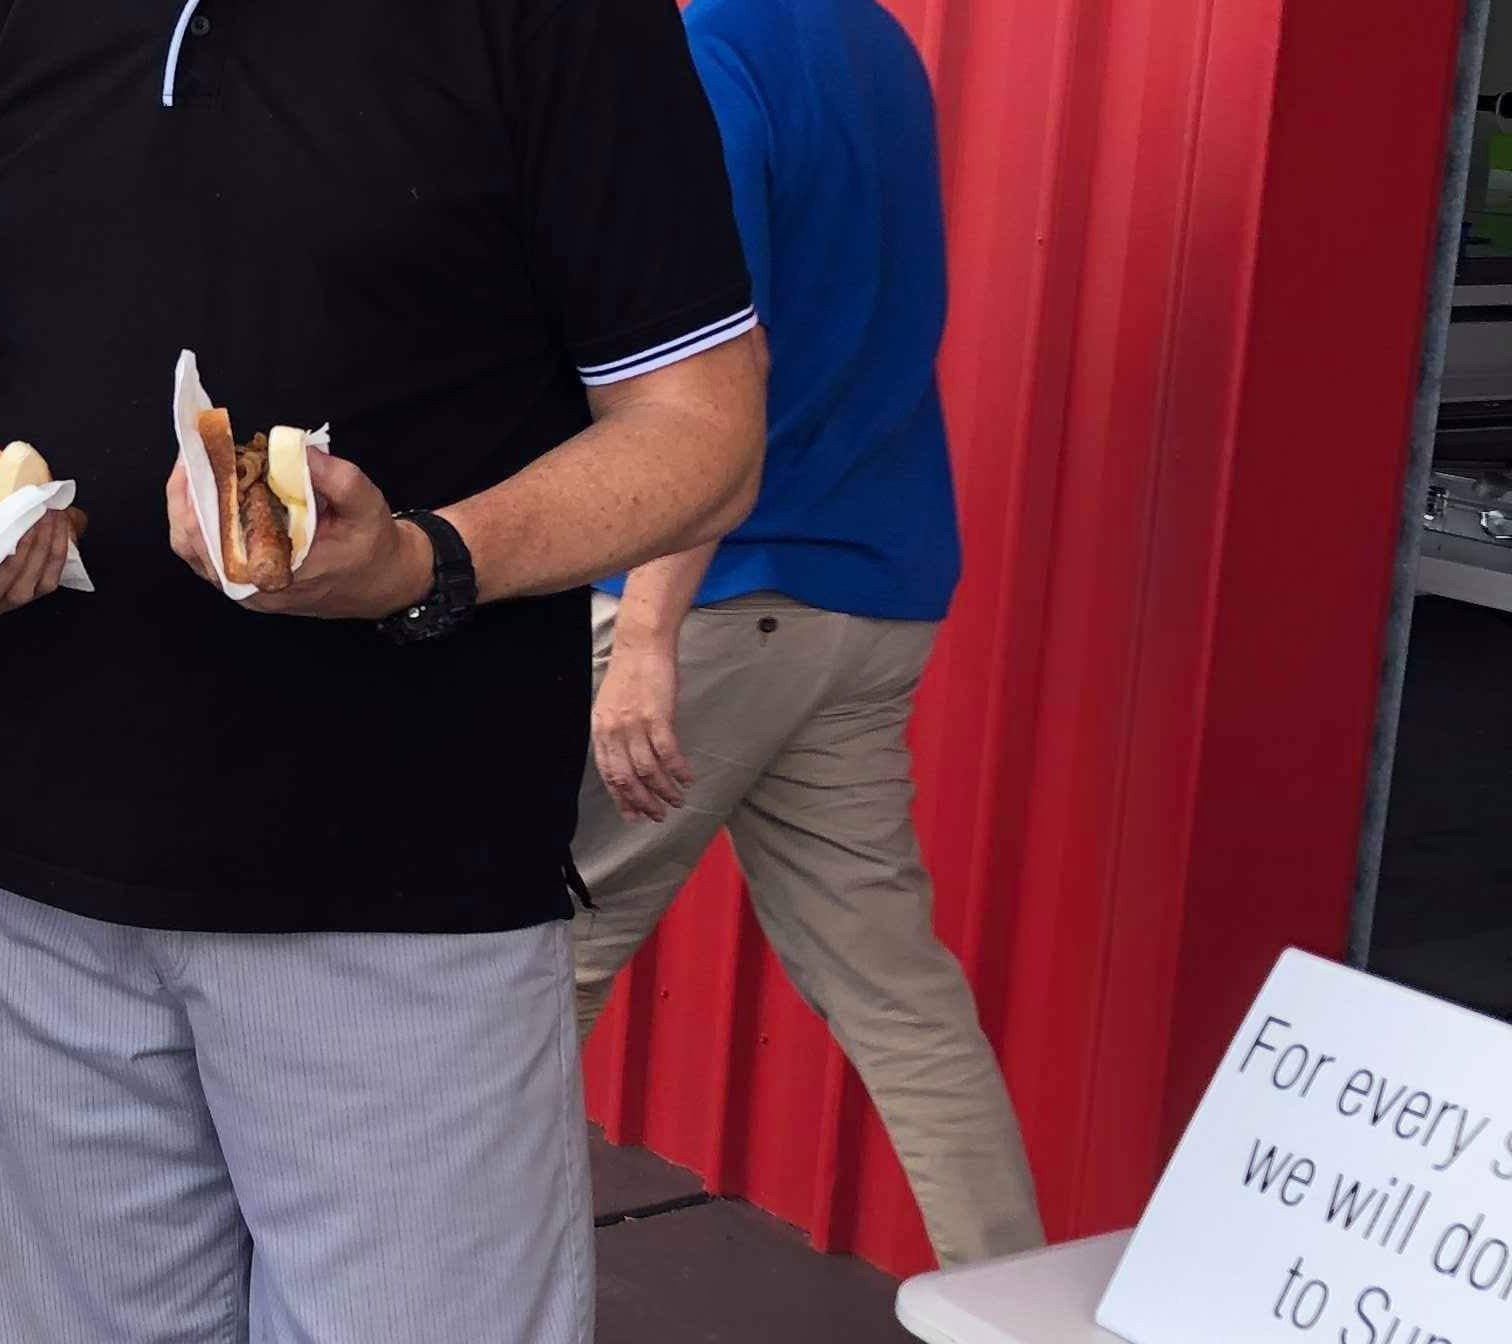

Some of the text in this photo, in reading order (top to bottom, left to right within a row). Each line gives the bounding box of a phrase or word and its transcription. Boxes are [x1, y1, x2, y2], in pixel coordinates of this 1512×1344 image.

[1238, 1016, 1336, 1098] For
[1336, 1068, 1492, 1172] every
[1242, 1138, 1317, 1207] we
[1325, 1175, 1432, 1255] will
[1273, 1256, 1331, 1332] to
